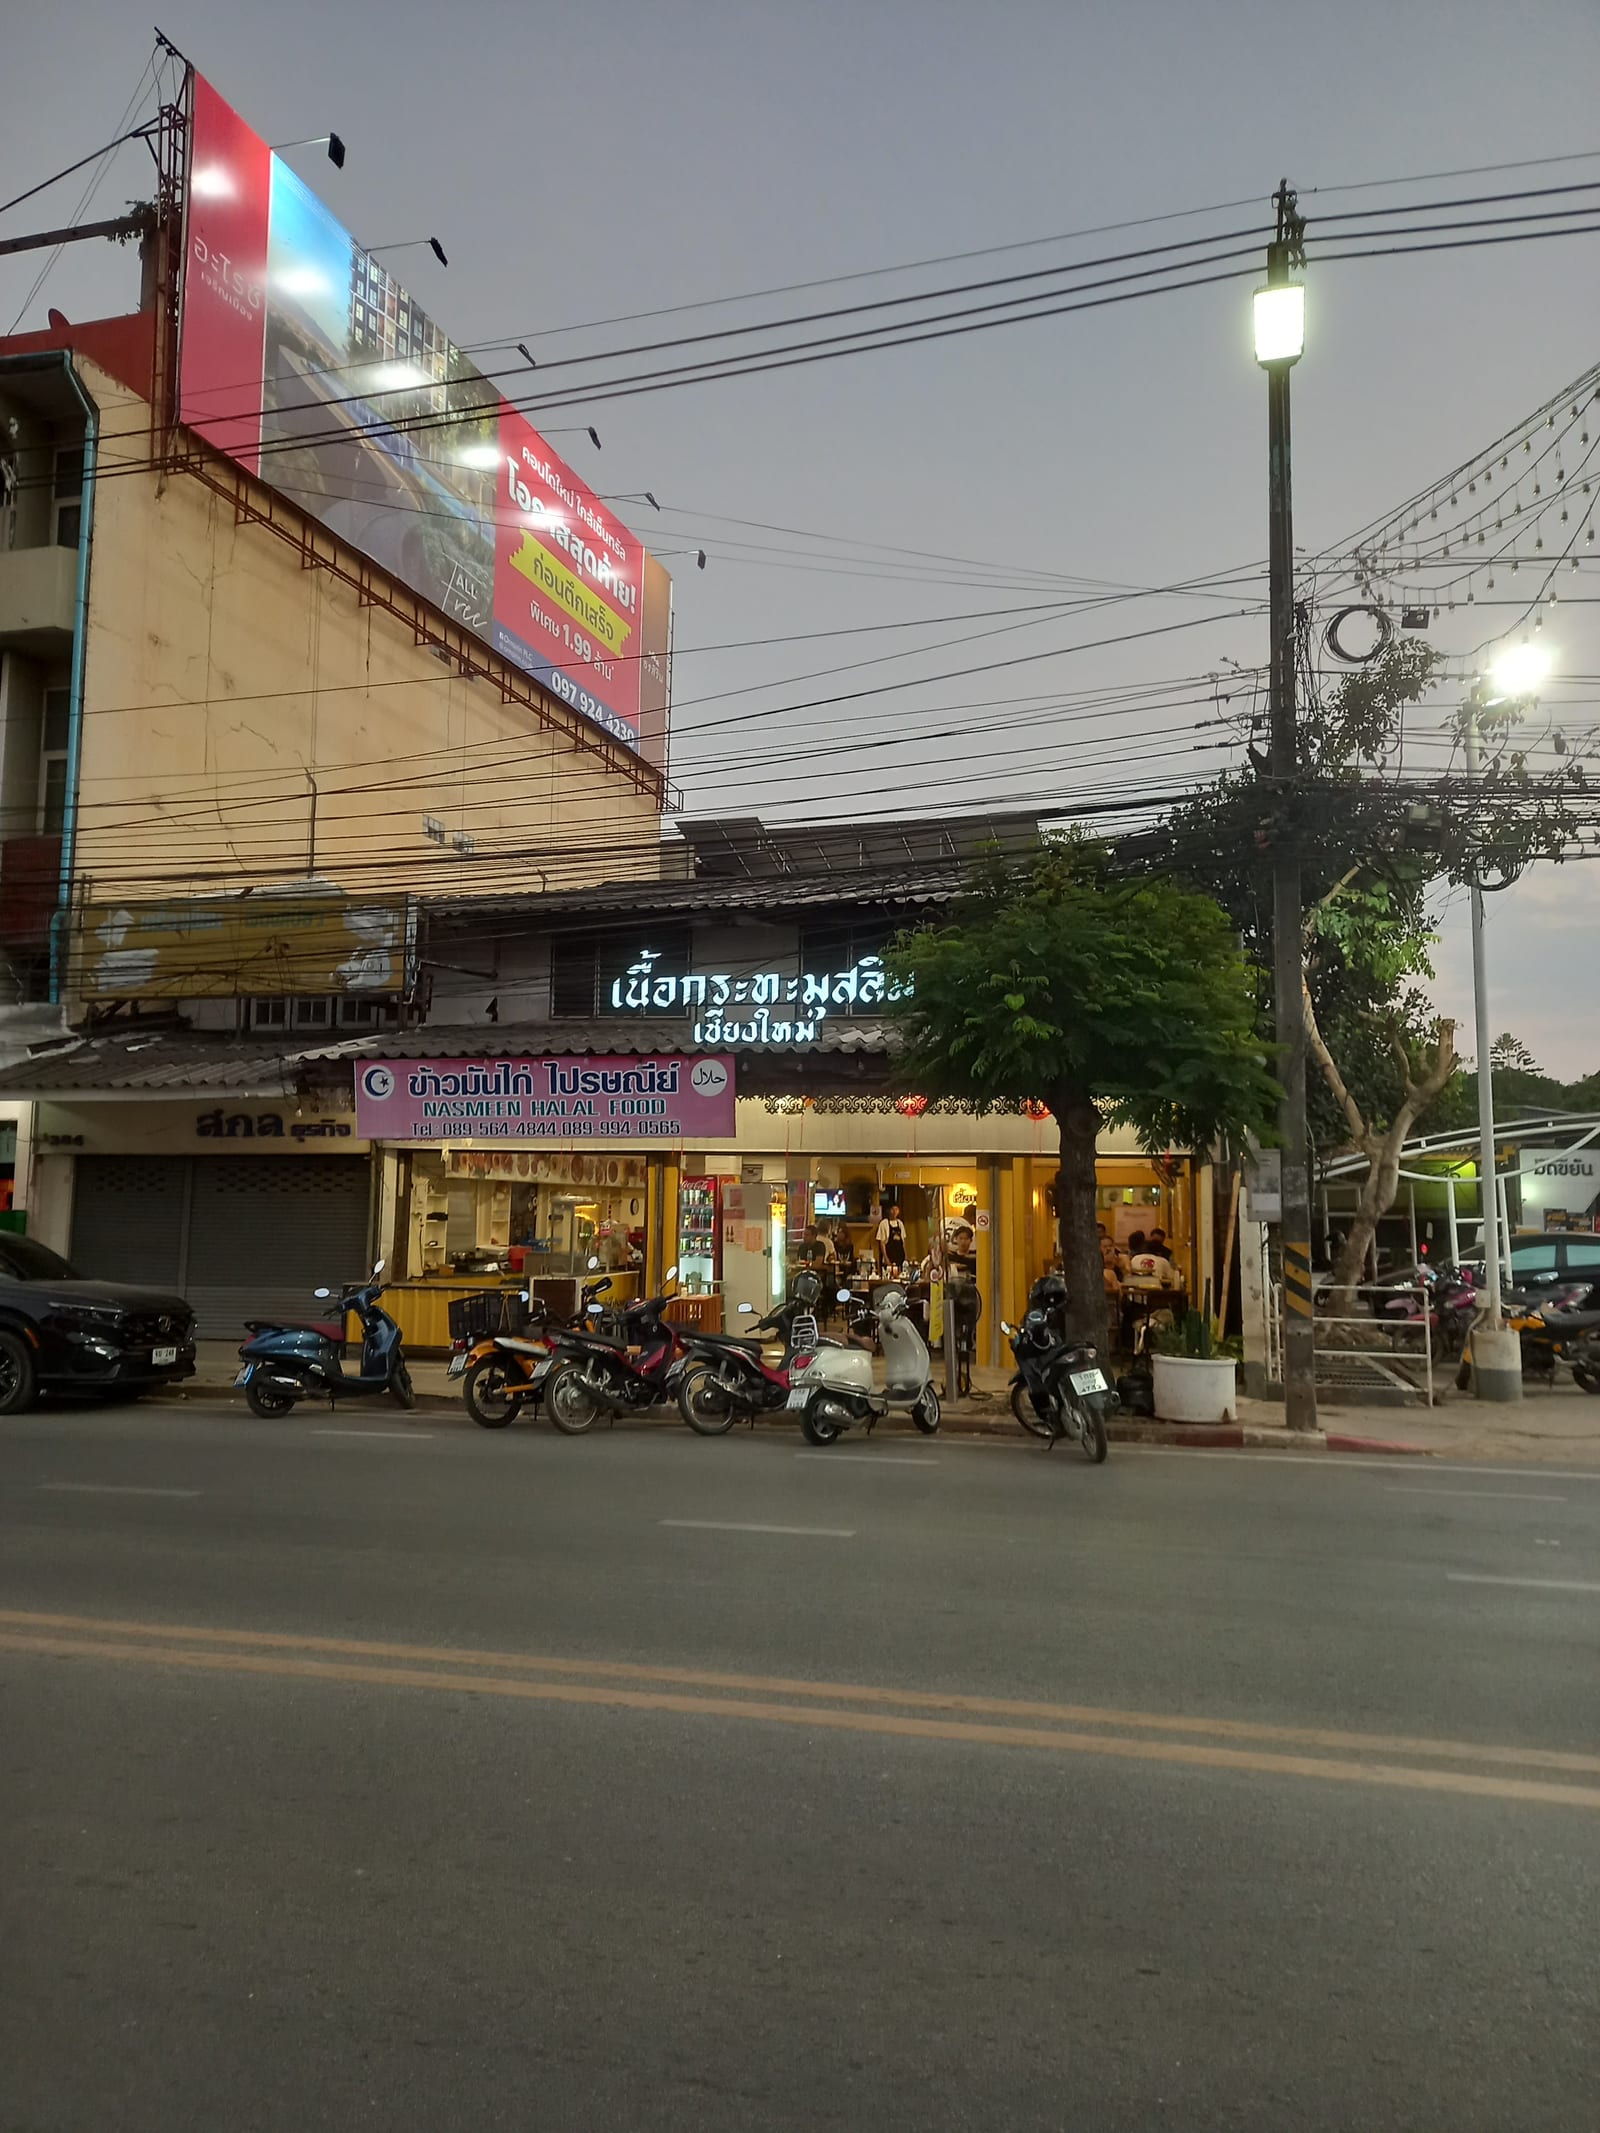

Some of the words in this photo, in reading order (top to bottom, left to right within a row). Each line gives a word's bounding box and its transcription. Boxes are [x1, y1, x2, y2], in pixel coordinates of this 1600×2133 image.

[533, 552, 614, 641] ก่อนตึกเสร็จ
[530, 600, 561, 638] พิเศษ
[562, 623, 592, 663] 1.99
[551, 671, 577, 704] 097
[579, 690, 603, 725] 924
[604, 712, 636, 748] 4230
[693, 1008, 815, 1044] เชียงใหม่
[409, 1062, 533, 1097] ข้าวมันไก่
[543, 1061, 680, 1095] ไปรษณีย์
[692, 1068, 726, 1086] حلال
[423, 1100, 522, 1117] NASMEEN
[531, 1100, 599, 1117] HALAL
[609, 1098, 667, 1116] FOOD
